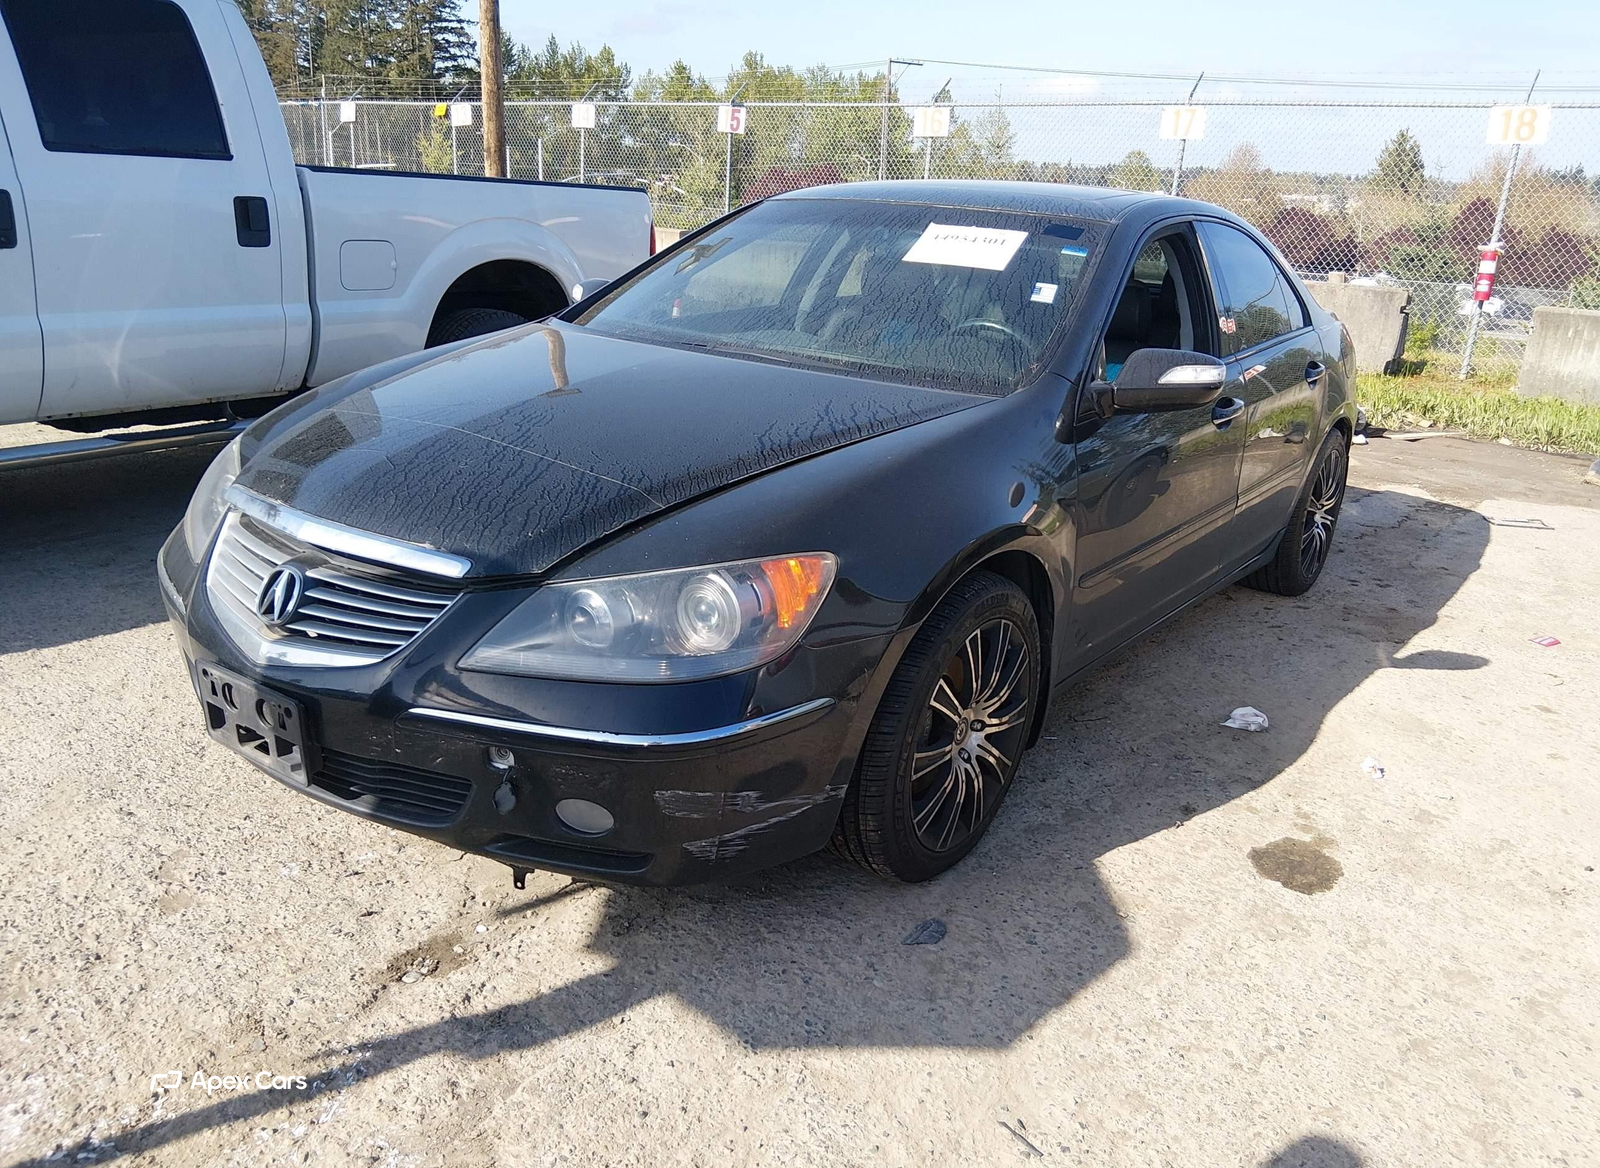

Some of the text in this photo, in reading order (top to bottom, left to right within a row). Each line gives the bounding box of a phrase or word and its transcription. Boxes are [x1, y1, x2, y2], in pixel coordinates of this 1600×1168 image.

[922, 109, 943, 133] 16
[1173, 109, 1197, 136] 17
[1501, 109, 1537, 141] 18
